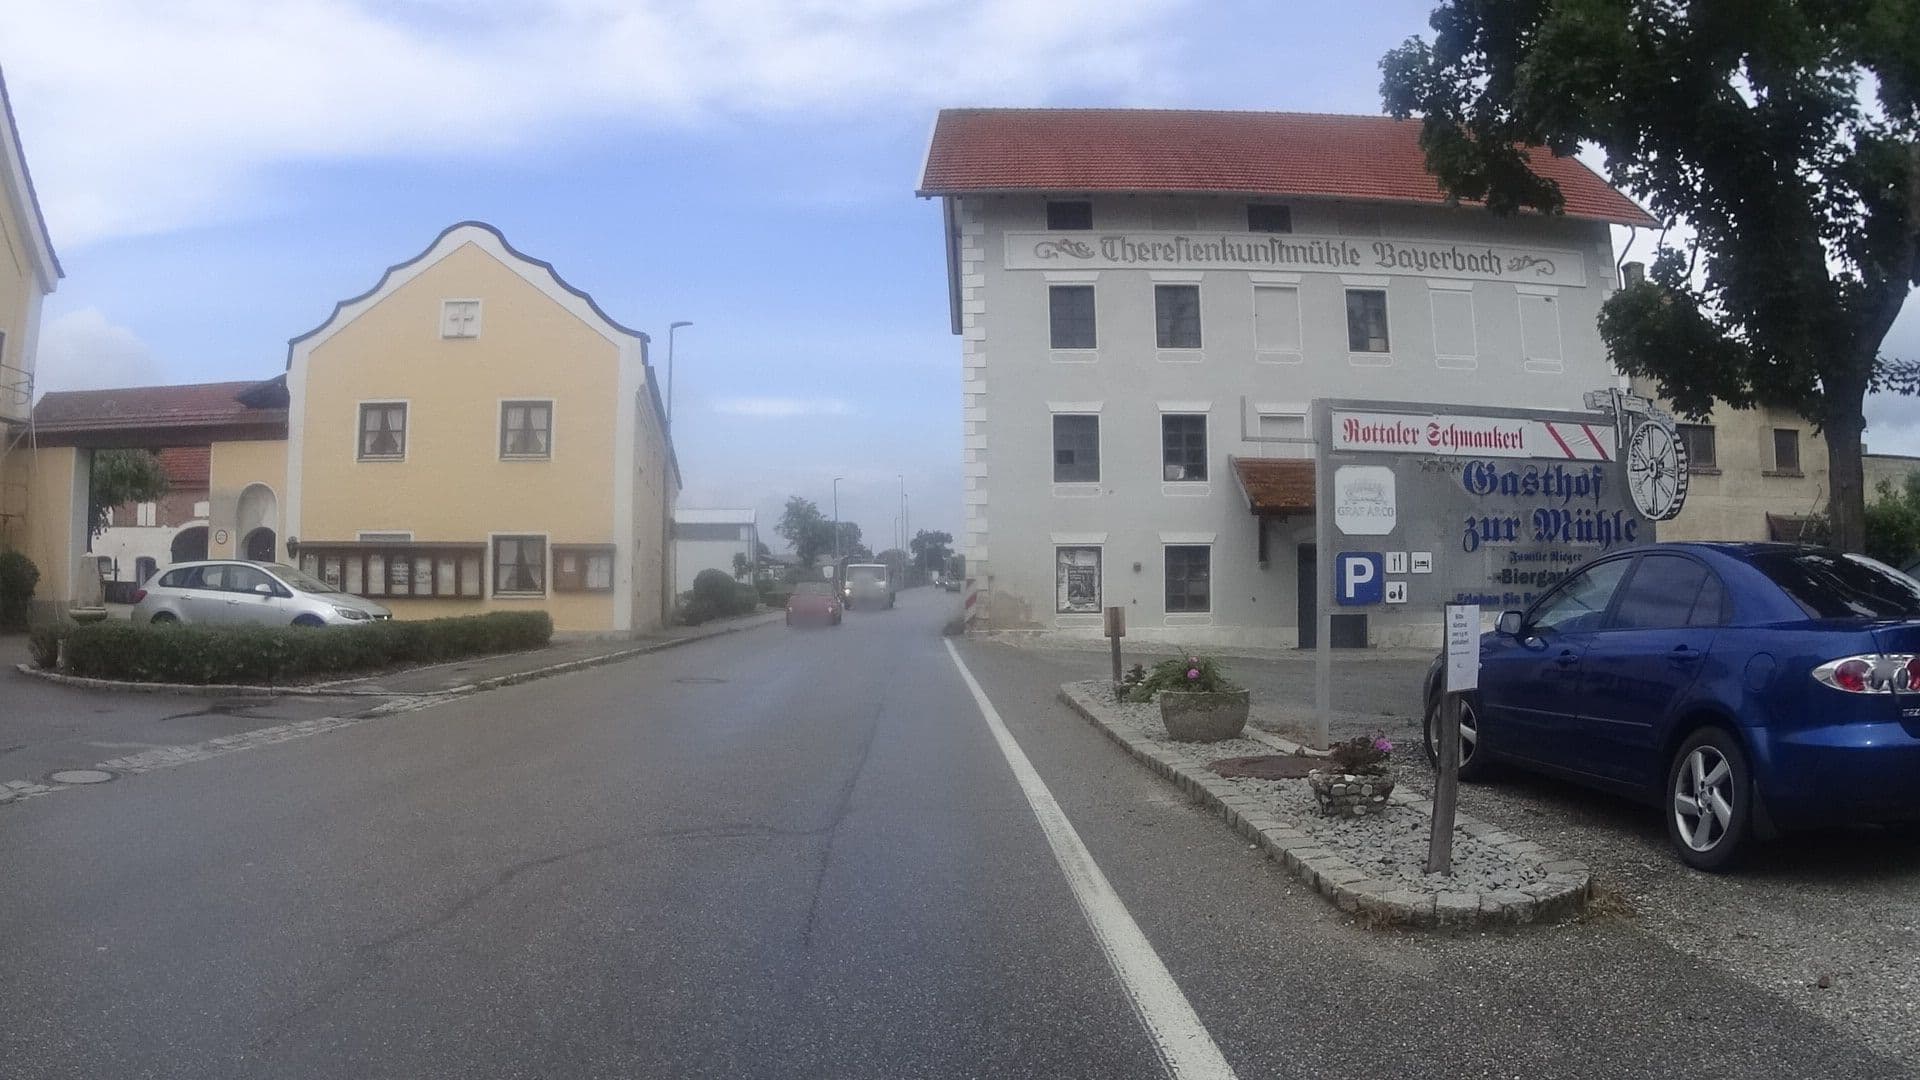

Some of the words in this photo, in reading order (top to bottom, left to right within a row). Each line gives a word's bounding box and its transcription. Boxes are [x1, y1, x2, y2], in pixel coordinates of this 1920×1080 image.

[1372, 241, 1502, 275] Bayerbach
[1343, 418, 1419, 446] Rottaler
[1426, 422, 1524, 452] Schmankerl
[1463, 460, 1603, 506] Gasthof
[1463, 516, 1521, 553] zur
[1533, 507, 1637, 550] Mühle
[1345, 557, 1374, 598] P
